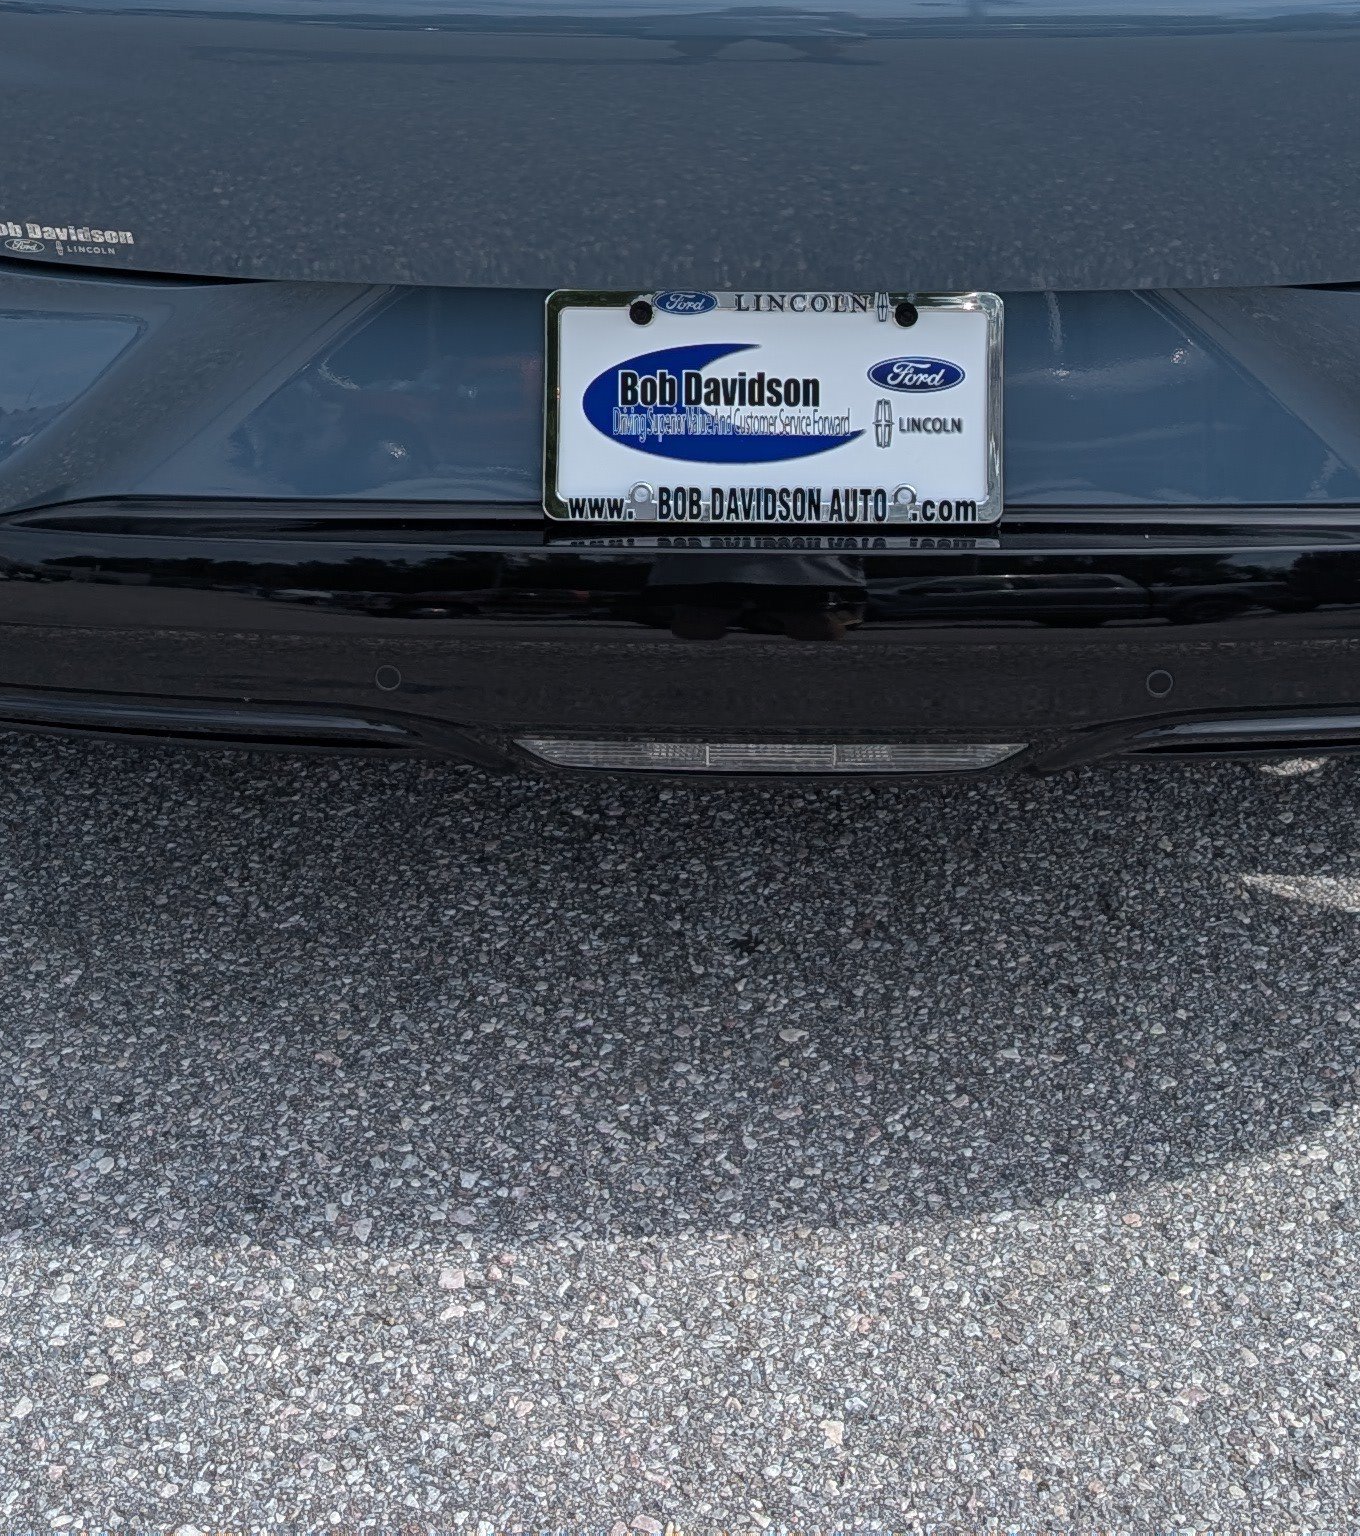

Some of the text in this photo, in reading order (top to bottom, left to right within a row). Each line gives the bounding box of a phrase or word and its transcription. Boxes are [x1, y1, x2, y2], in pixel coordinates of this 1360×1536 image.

[25, 222, 135, 245] Davidson
[66, 245, 116, 255] LINCOLN
[664, 292, 870, 314] Ford LINCOLN
[886, 361, 946, 386] Ford
[618, 370, 821, 408] Bob Davidson
[612, 407, 646, 443] Driving
[898, 417, 963, 433] LINCOLN
[568, 486, 979, 522] www. BOB DAVIDSON AUTO .com
